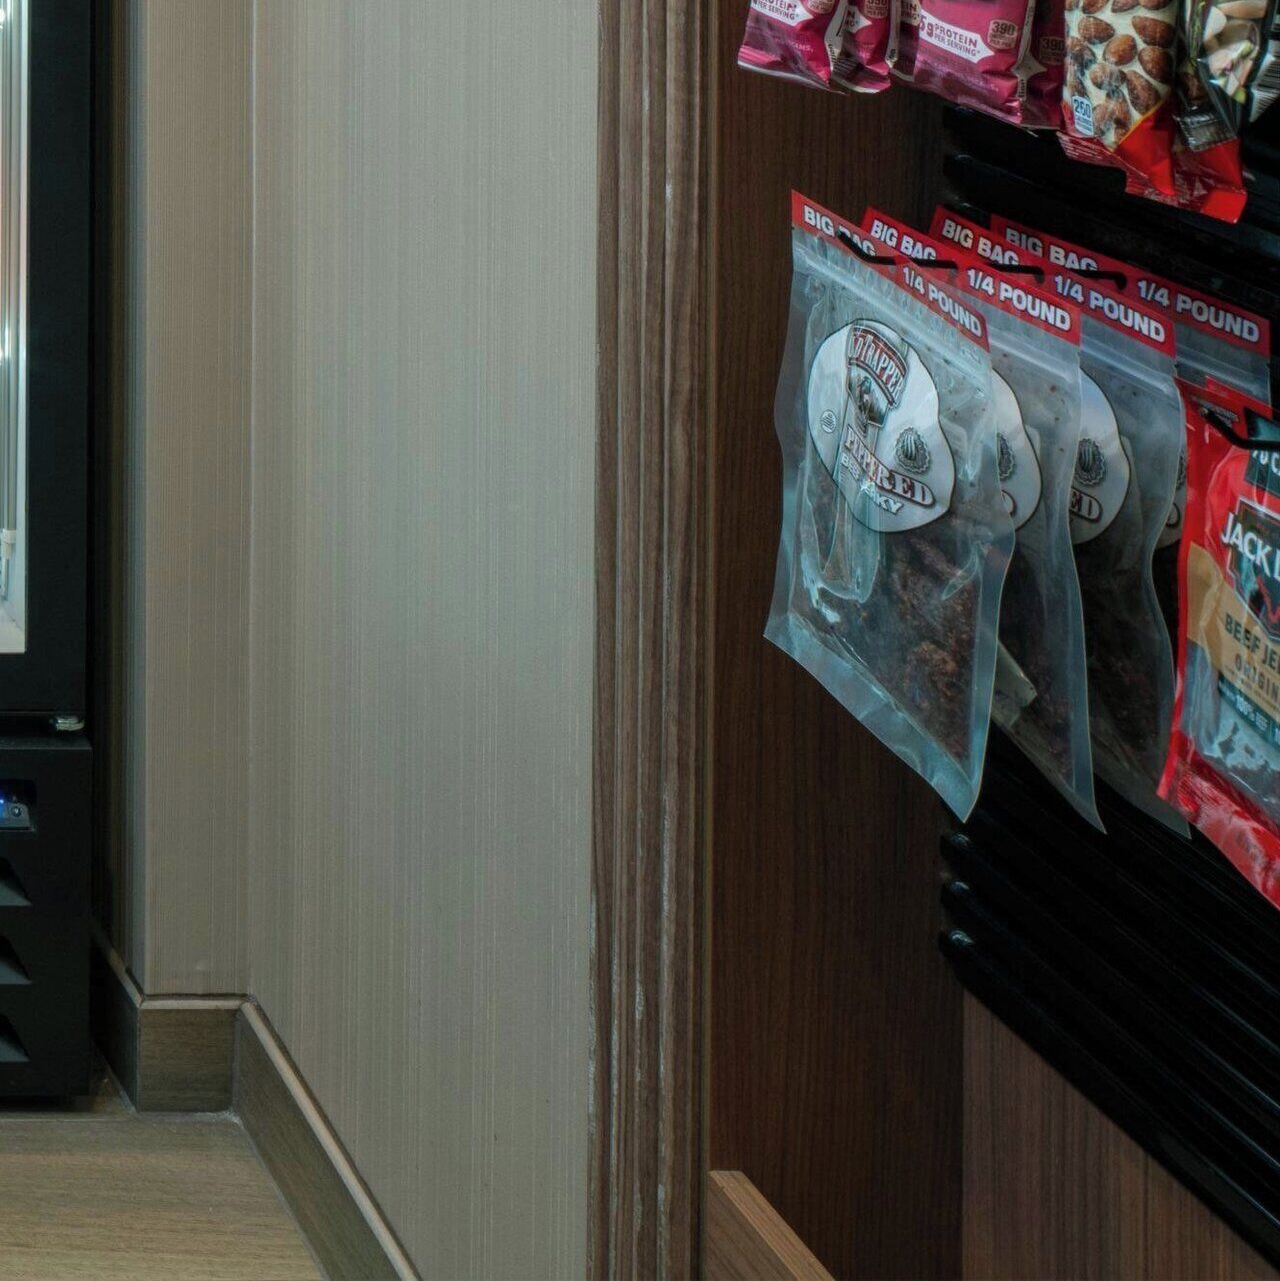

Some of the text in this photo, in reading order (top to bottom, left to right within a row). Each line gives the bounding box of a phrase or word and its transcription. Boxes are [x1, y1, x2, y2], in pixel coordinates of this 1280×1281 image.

[935, 23, 978, 48] PROTEIN
[992, 22, 1016, 36] 390
[803, 204, 835, 238] BIG
[870, 219, 937, 260] BIG BAG
[942, 219, 1019, 265] BIG BAG
[1005, 227, 1043, 258] BIG
[903, 266, 983, 338] 1/4 POUND
[967, 267, 1071, 332] 1/4 POUND
[1054, 274, 1165, 343] 1/4 POUND
[1138, 279, 1260, 343] 1/4 POUND
[1222, 512, 1270, 577] JACK
[1225, 613, 1260, 657] BEEF
